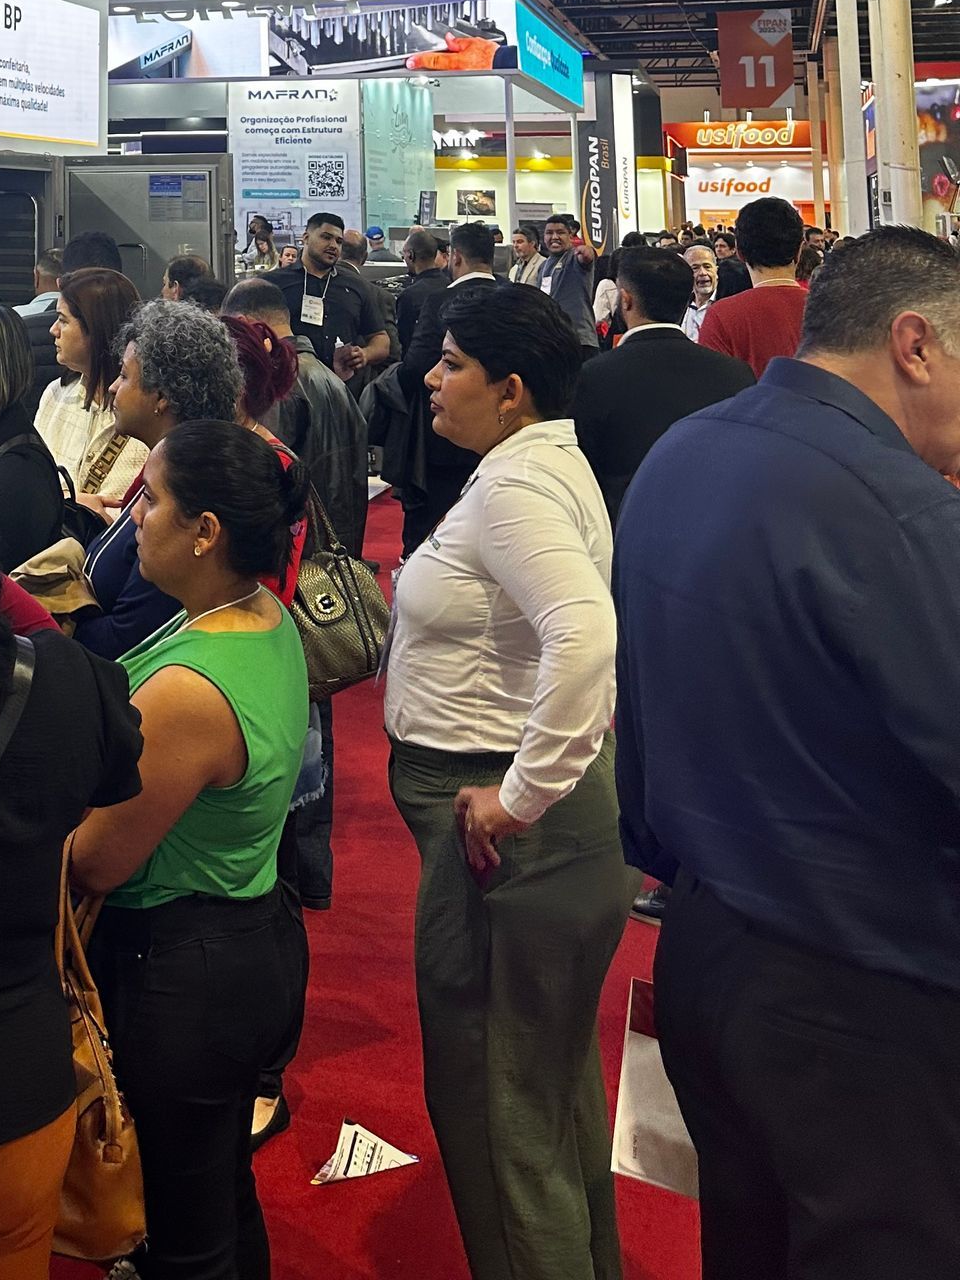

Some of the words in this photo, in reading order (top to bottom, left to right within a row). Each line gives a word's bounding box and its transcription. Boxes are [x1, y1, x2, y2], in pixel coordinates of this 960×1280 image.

[4, 3, 22, 31] BP
[757, 19, 787, 28] FIPAN
[143, 33, 189, 66] MAFRAN
[0, 57, 31, 76] confeitaria,
[738, 55, 776, 88] 11
[8, 77, 34, 94] múltiplas
[34, 81, 66, 98] velocidades
[247, 89, 328, 100] MAFRAN
[20, 97, 49, 113] qualidade!
[240, 115, 295, 125] Organização
[296, 114, 348, 123] Profissional
[244, 126, 280, 135] começa
[281, 126, 301, 134] com
[301, 125, 343, 134] Estrutura
[274, 136, 313, 145] Eficiente
[696, 122, 796, 149] usifood
[599, 138, 610, 169] Brasil
[587, 135, 603, 243] EUROPAN
[698, 176, 772, 197] usifood
